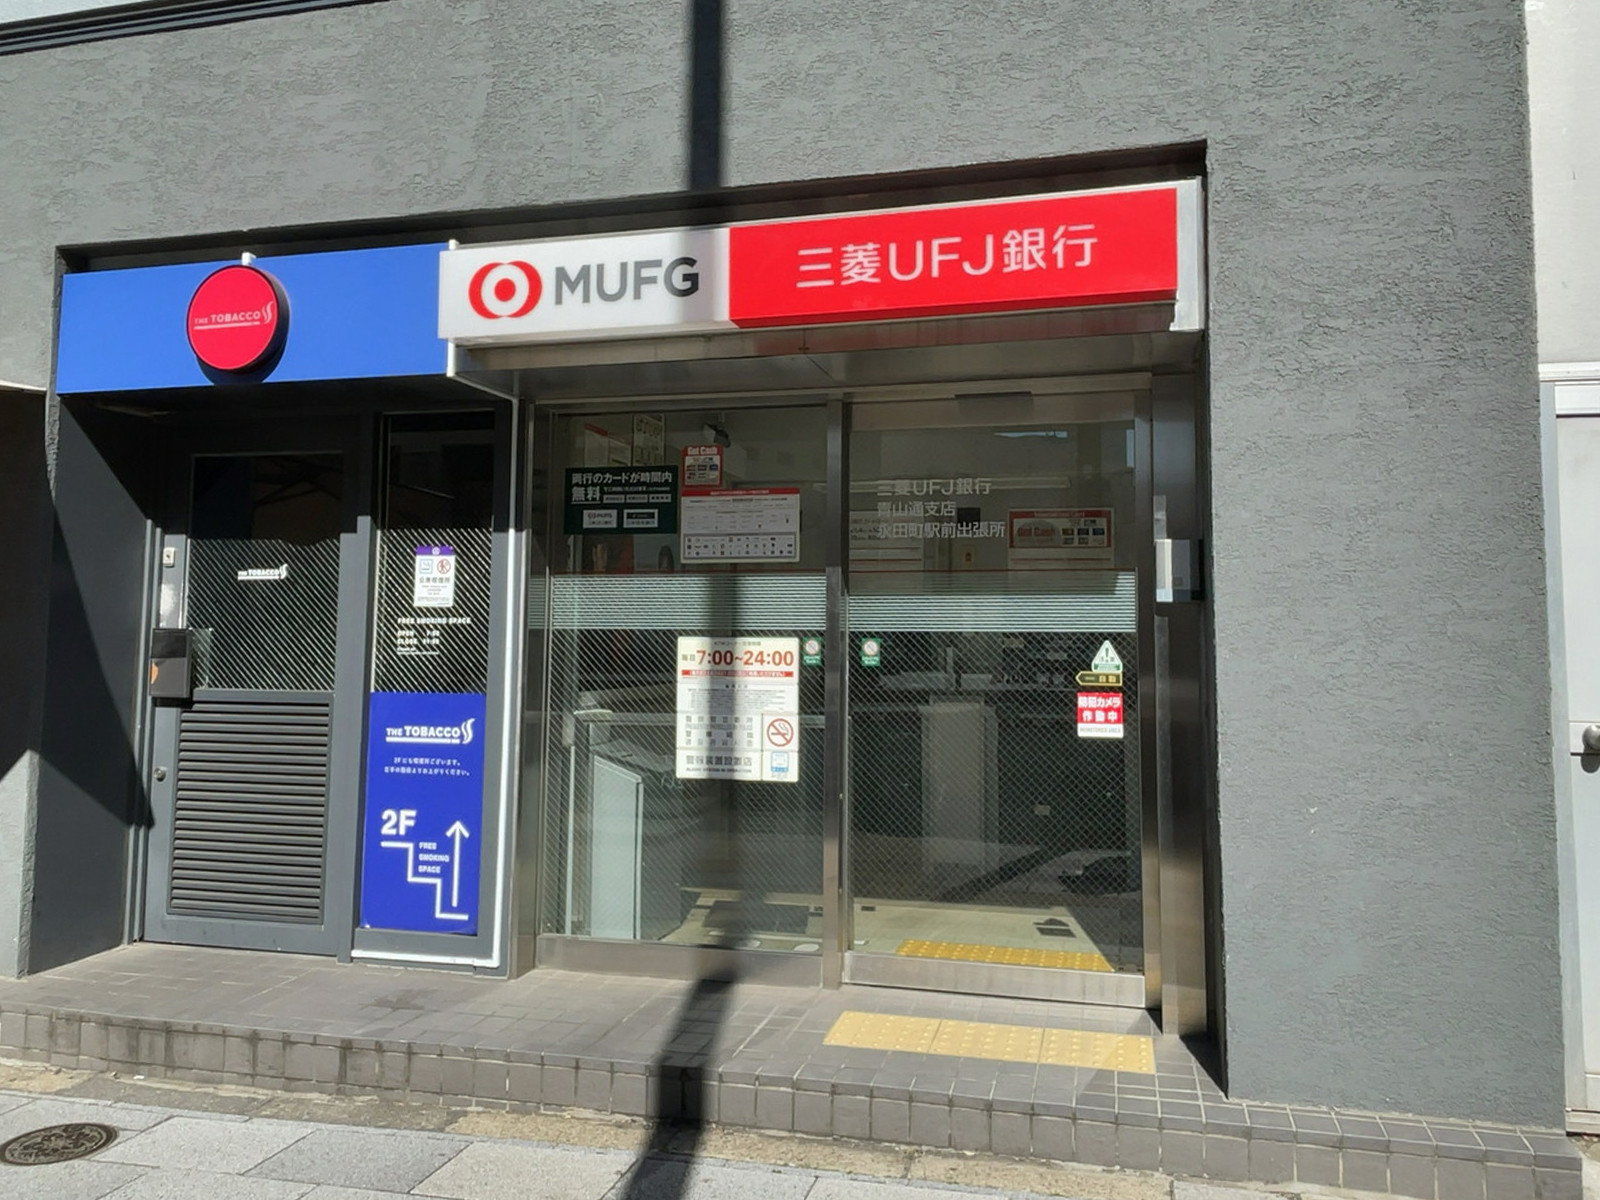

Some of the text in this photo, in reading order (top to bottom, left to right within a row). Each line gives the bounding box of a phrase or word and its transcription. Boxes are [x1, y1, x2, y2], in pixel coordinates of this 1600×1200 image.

[796, 224, 1098, 288] 三菱UFJ銀行
[555, 256, 699, 305] MUFG
[210, 311, 261, 323] TOBACCO
[571, 486, 600, 502] 無料
[877, 477, 993, 496] 三菱UFJ銀行
[877, 501, 957, 517] 青山通支店
[878, 521, 1006, 539] 永田町駅前出張所
[248, 569, 279, 577] TOBACCO
[386, 726, 460, 738] THE TOBACCO
[381, 808, 417, 835] 2F
[418, 842, 437, 850] FREE
[418, 854, 450, 862] SMOKING
[418, 865, 441, 873] SPACE
